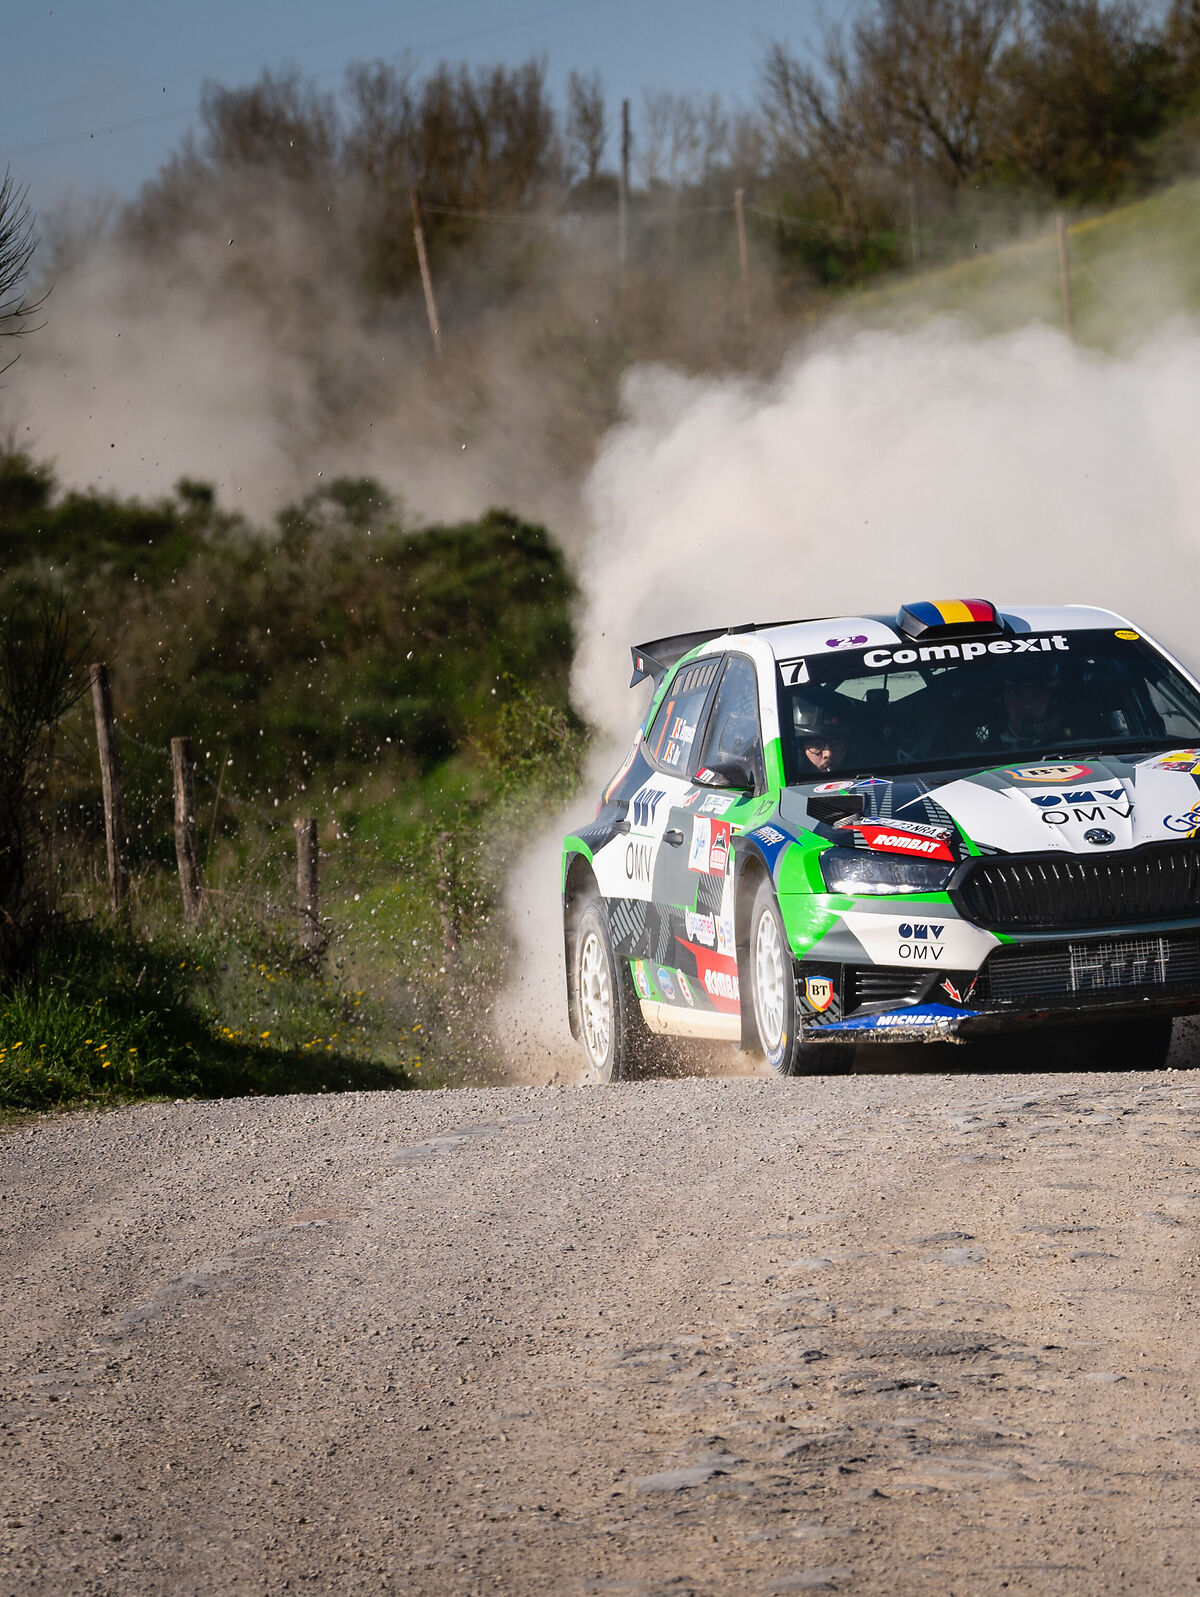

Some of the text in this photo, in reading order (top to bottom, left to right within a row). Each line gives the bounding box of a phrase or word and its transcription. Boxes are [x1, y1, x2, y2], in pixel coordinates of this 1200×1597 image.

[863, 635, 1069, 668] Compexit
[780, 661, 804, 683] 7
[1028, 766, 1073, 778] BT
[1041, 804, 1134, 825] OMV
[872, 834, 941, 853] ROMBAT
[626, 842, 653, 882] OMV
[898, 944, 944, 960] OMV
[704, 968, 741, 1001] ROMBA
[812, 983, 828, 996] BT
